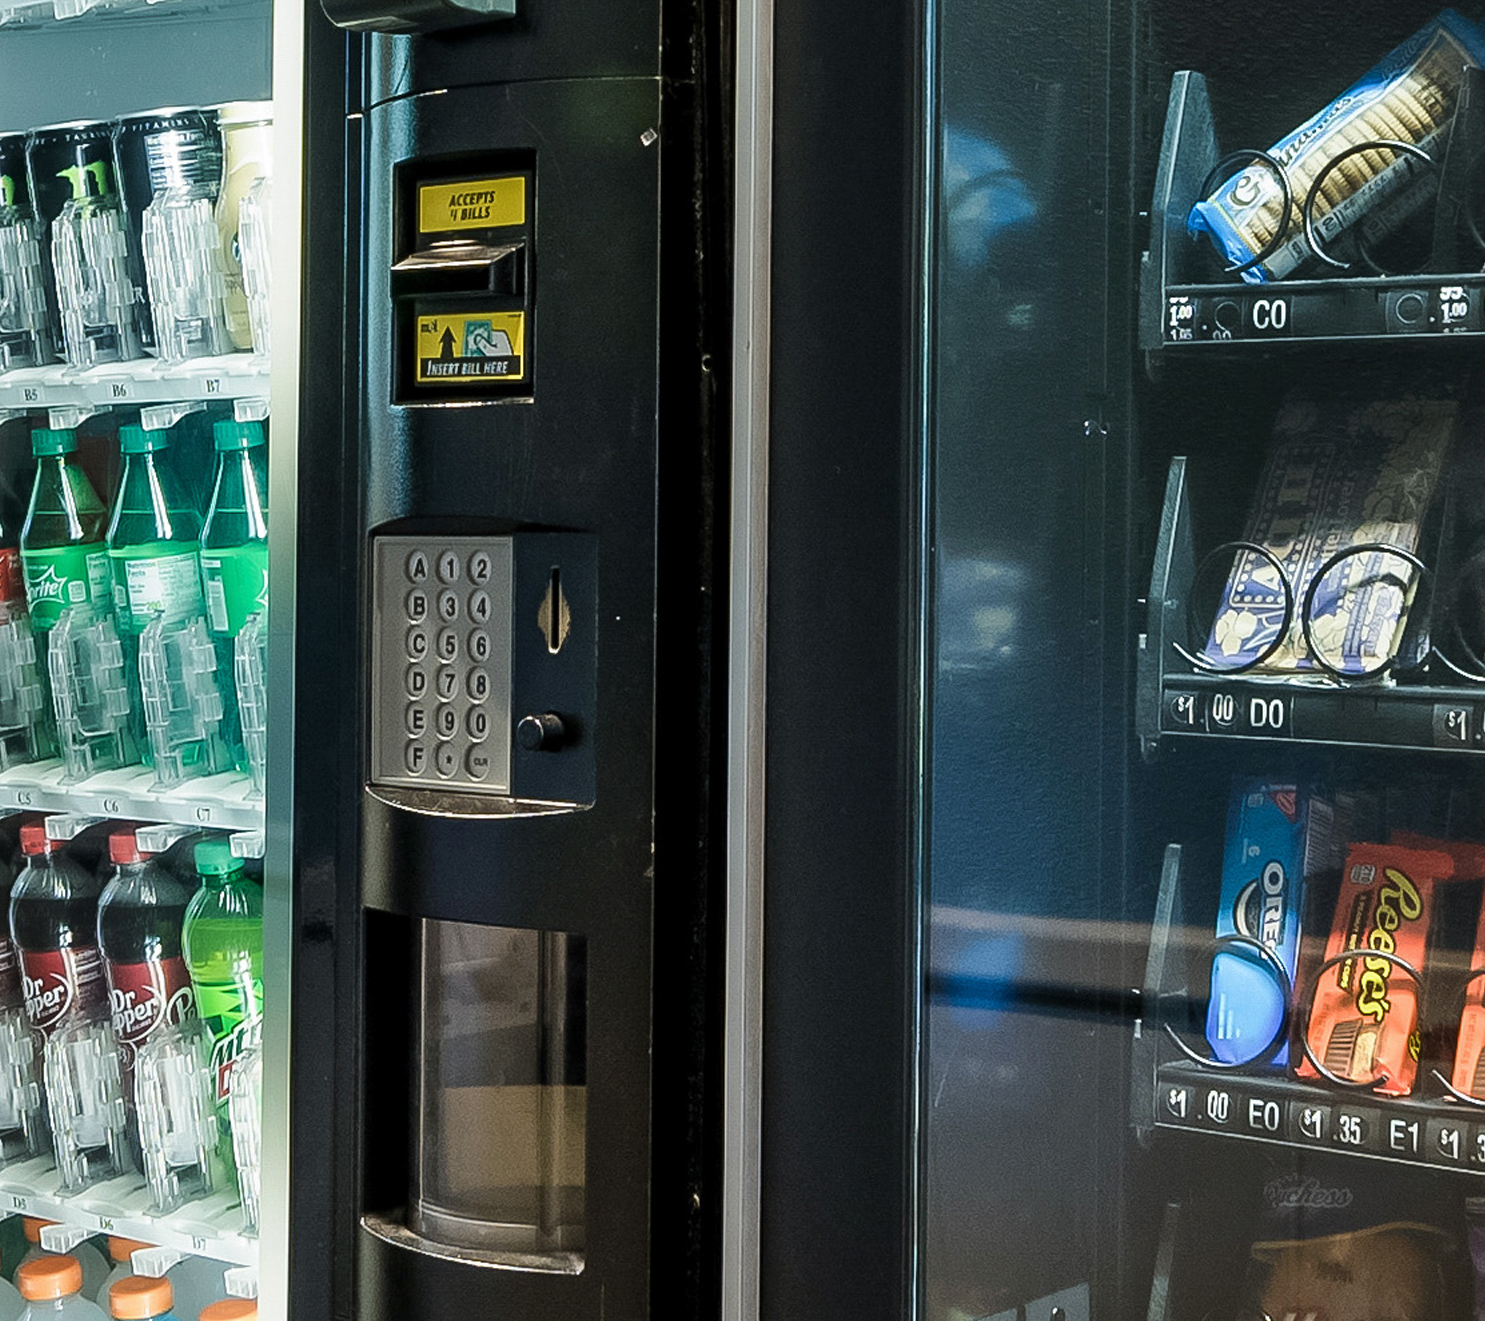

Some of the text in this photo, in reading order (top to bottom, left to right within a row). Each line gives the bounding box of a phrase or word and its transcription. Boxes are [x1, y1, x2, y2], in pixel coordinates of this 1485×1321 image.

[449, 190, 495, 207] ACCEPTS
[461, 206, 491, 221] BILLS
[1252, 299, 1287, 330] C0
[427, 360, 508, 376] INSERT BILL HERE
[24, 378, 221, 402] B5 B6 B7
[414, 558, 487, 578] A 1 2
[414, 596, 487, 617] B 3 4
[413, 633, 486, 656] C 5 6
[414, 671, 486, 695] D 7 8
[414, 710, 486, 733] E 9 0
[1249, 698, 1285, 728] D0
[414, 748, 423, 767] F
[104, 798, 211, 822] C6 C7
[1358, 868, 1423, 1023] Reese's
[1249, 1099, 1279, 1131] E0
[1390, 1120, 1419, 1151] E1
